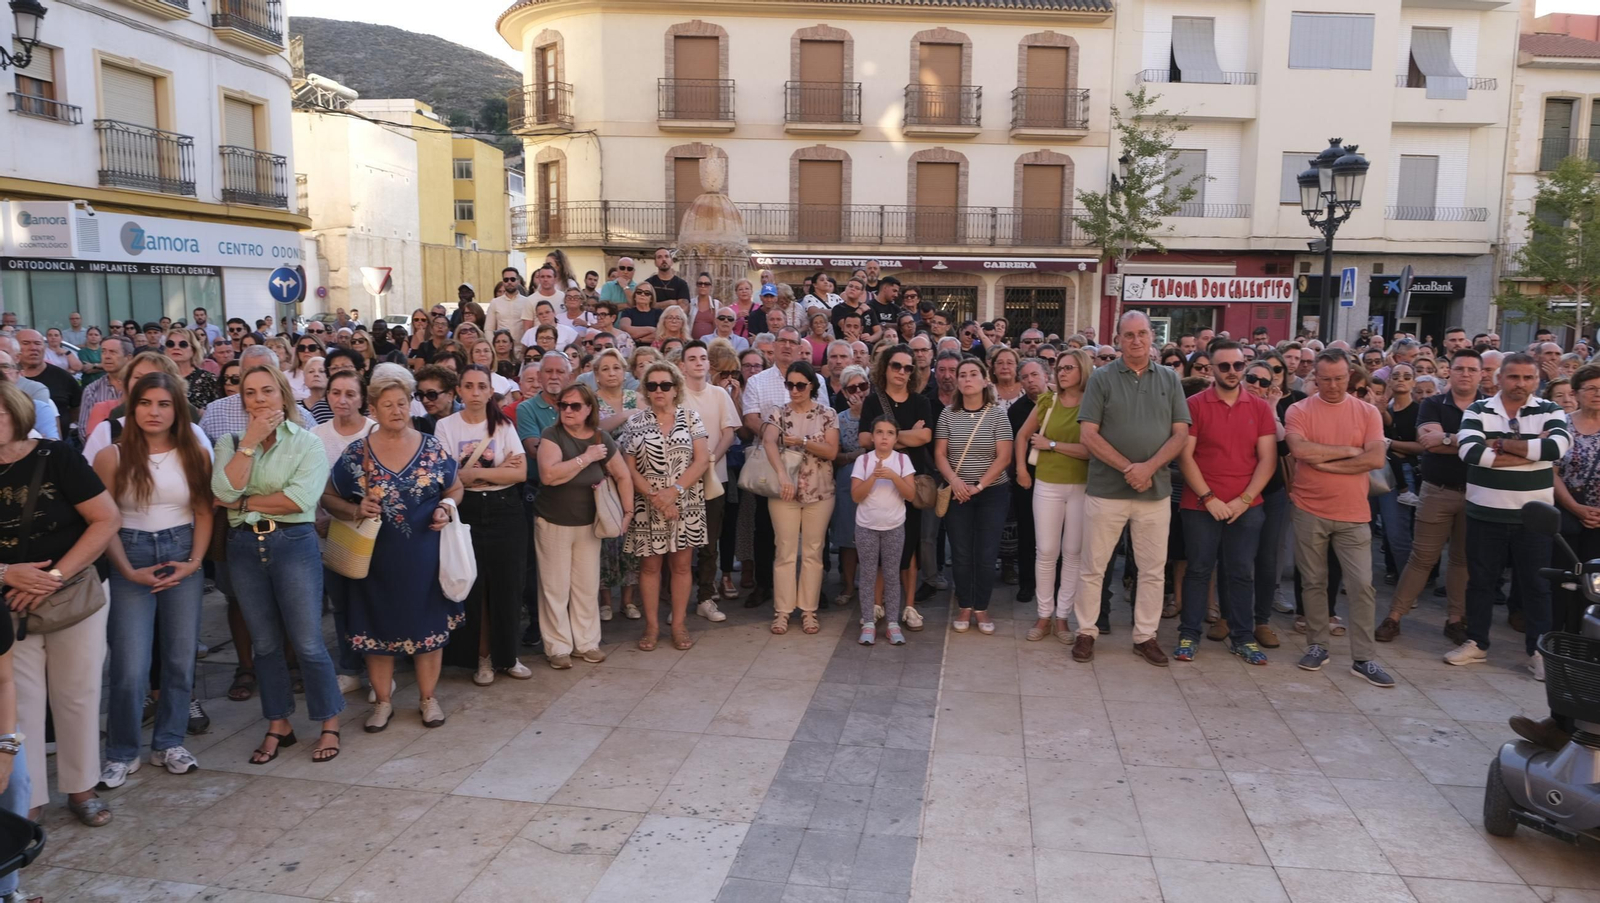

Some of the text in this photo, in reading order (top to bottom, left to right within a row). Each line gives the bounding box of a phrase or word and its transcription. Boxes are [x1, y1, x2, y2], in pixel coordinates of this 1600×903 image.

[22, 213, 67, 226] Zamora
[129, 228, 200, 253] Zamora
[218, 241, 301, 259] CENTRO ODON
[8, 260, 215, 276] ORTODONCIA IMPLANTES ESTÉTICA DENTAL
[757, 257, 823, 266] CAFETERIA
[983, 261, 1037, 269] CABRERA
[1150, 278, 1198, 299] TAHONA
[1408, 281, 1453, 291] aixaBank
